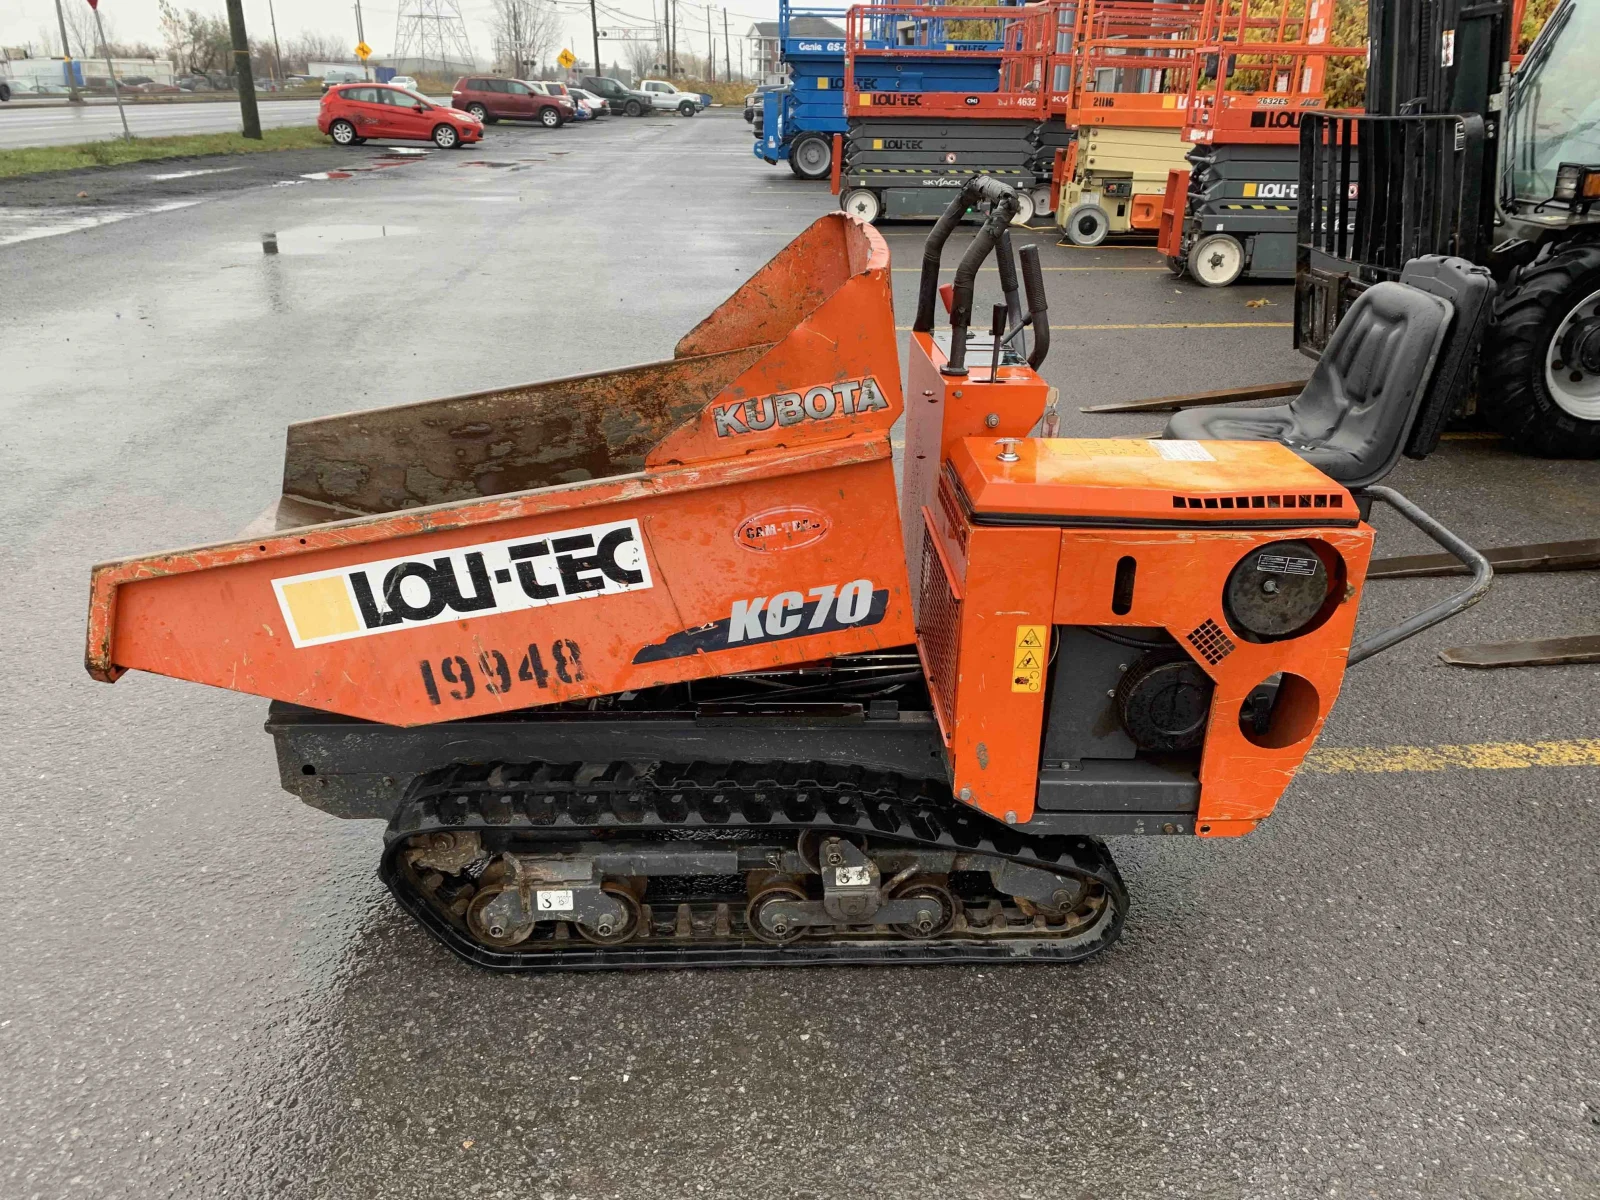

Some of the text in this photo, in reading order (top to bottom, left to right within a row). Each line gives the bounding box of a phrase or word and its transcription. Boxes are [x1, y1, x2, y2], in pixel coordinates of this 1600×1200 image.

[799, 42, 823, 51] Genie
[830, 77, 878, 89] LO-TEC
[873, 93, 923, 106] LOU-TEC
[1017, 97, 1037, 107] 4632
[1257, 97, 1289, 106] 2632ES
[1300, 98, 1321, 107] JLG
[883, 139, 923, 150] LOU-TEC
[922, 178, 962, 187] SKYJACK
[1257, 183, 1300, 198] LOU-T
[712, 377, 890, 438] KUBOTA
[348, 526, 644, 630] LOU-TEC
[727, 579, 874, 644] KC70
[420, 638, 585, 706] 19948
